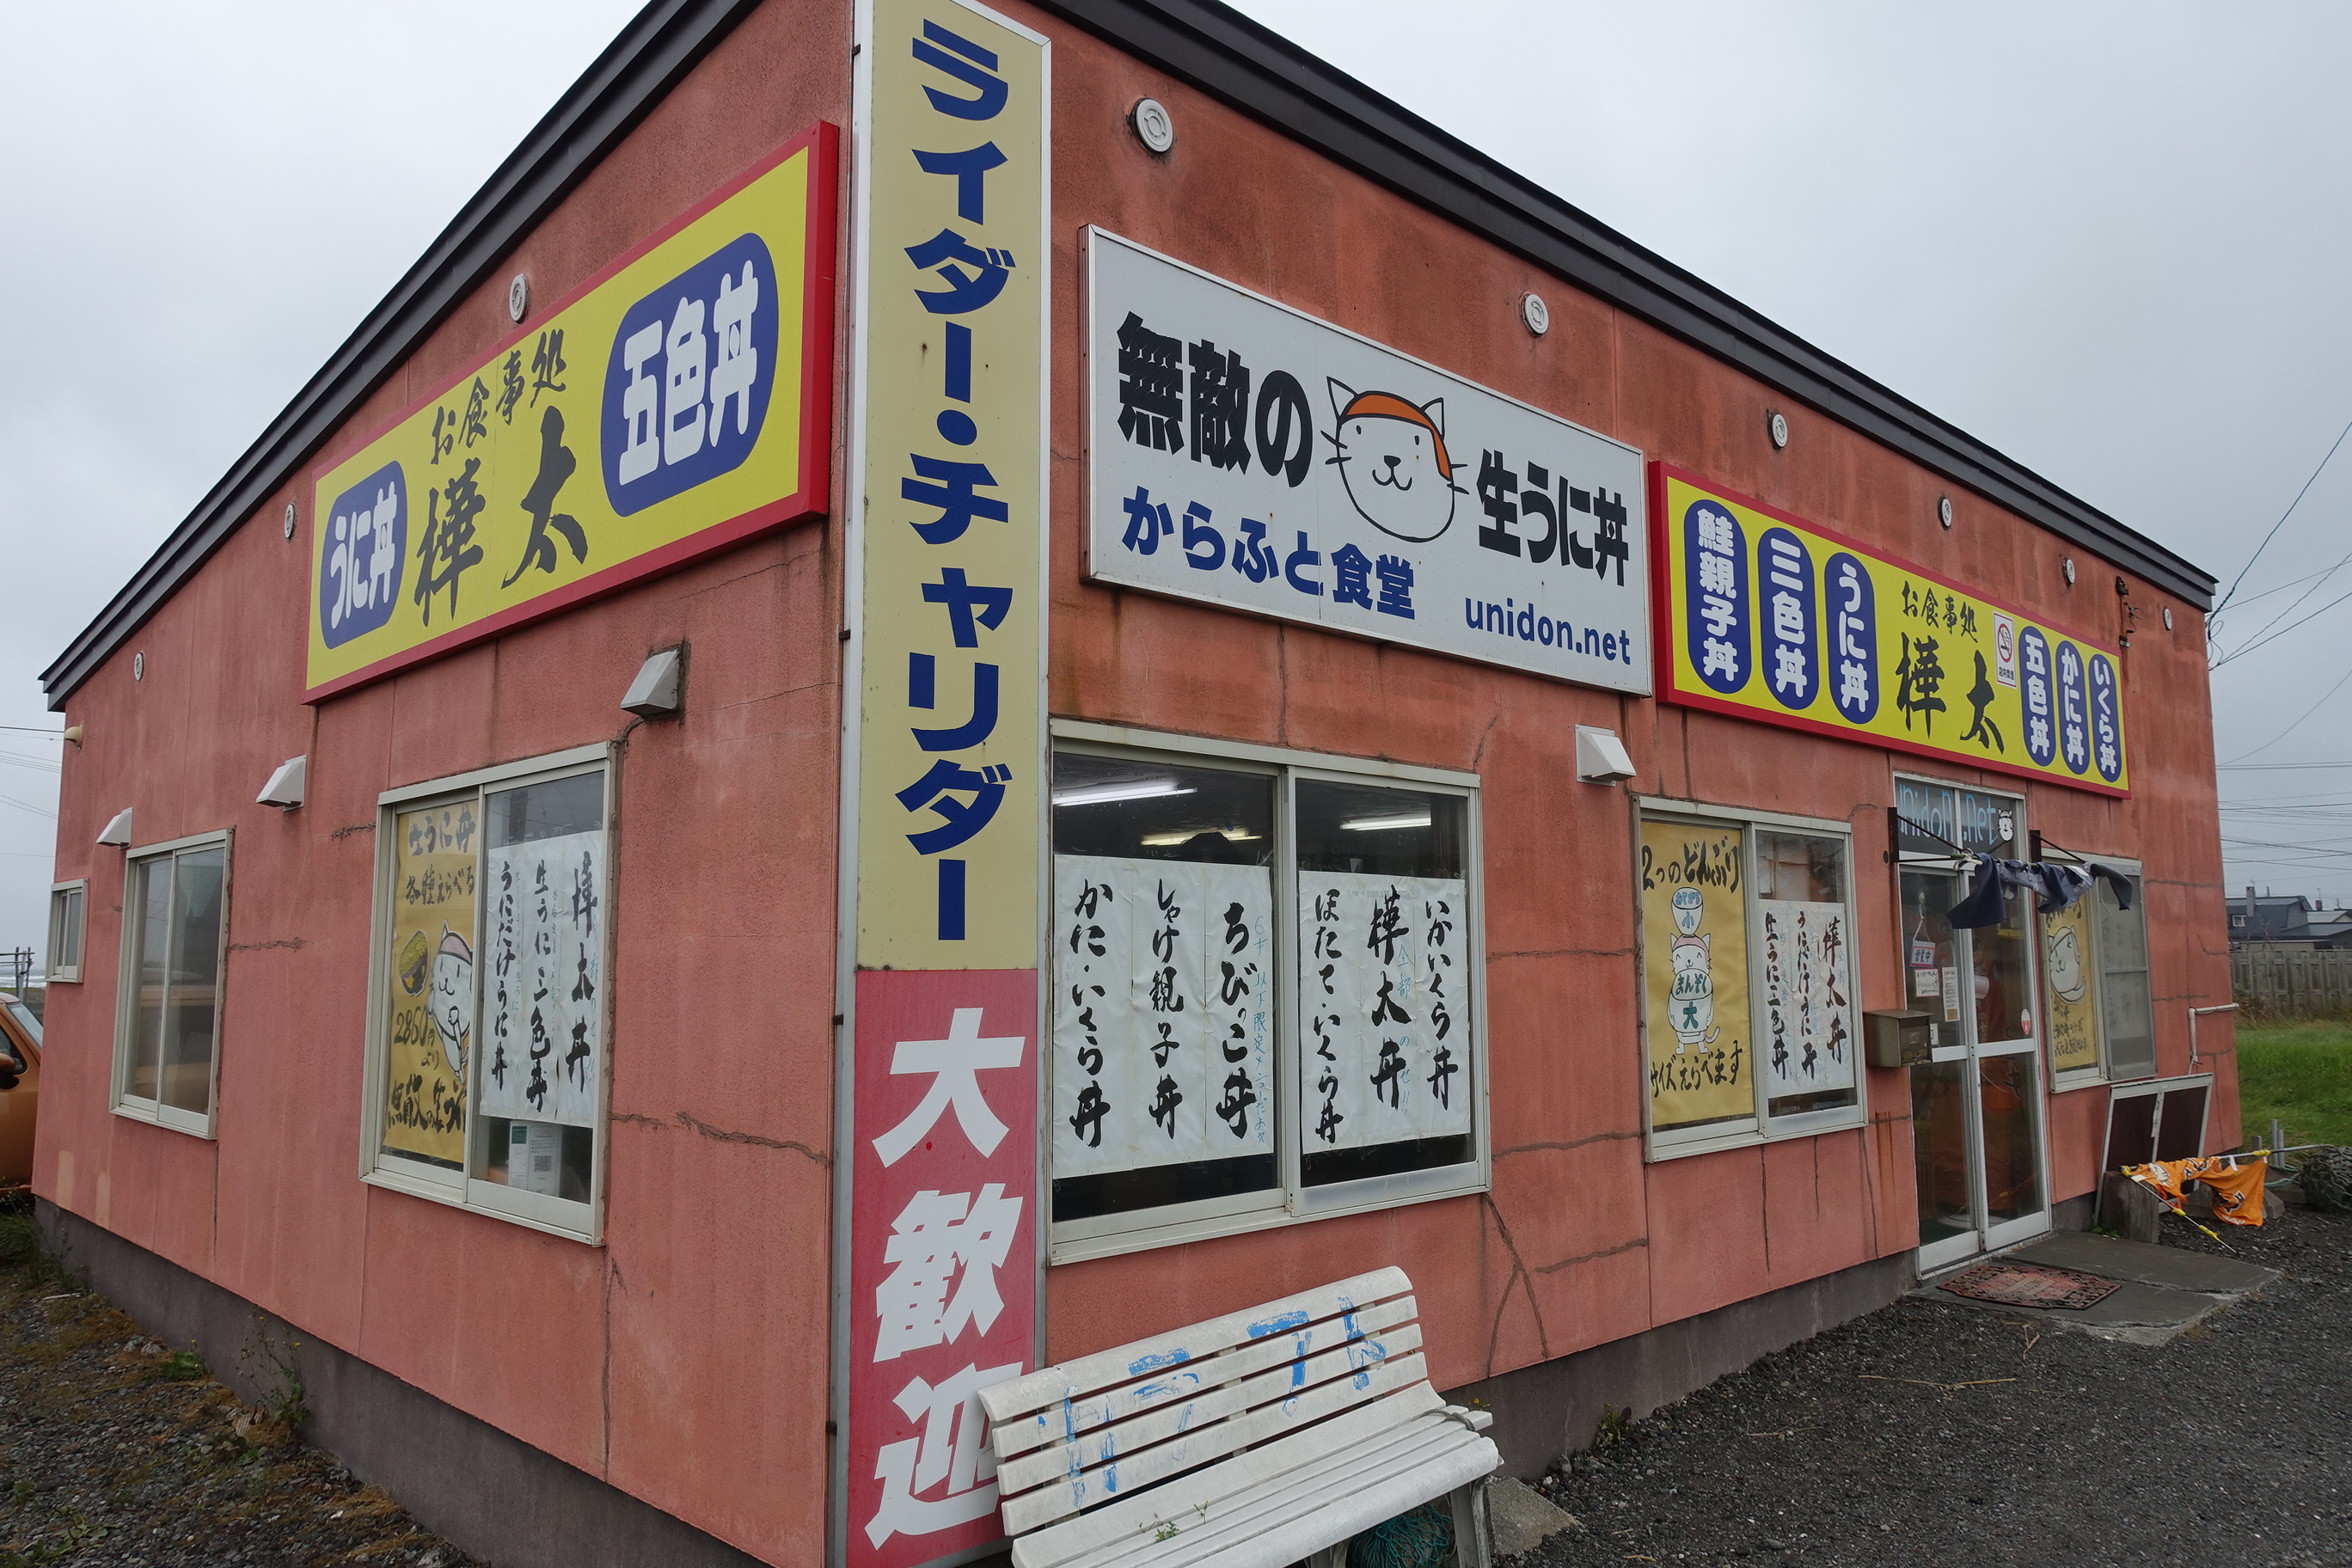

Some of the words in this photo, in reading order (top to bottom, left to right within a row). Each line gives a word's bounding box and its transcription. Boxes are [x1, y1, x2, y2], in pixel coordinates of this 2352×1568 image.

[431, 328, 567, 465] お食事処
[619, 260, 759, 486] 五色丼
[1117, 311, 1313, 487] 無敵の
[413, 405, 589, 628] 樺太
[895, 18, 1016, 940] ライダー・チャリダー
[1122, 485, 1415, 619] からふと食堂
[1476, 449, 1628, 586] 生うに丼
[330, 481, 398, 630] うに丼
[1697, 508, 1739, 682] 鮭親子丼
[1769, 537, 1808, 698] 三色丼
[1902, 580, 1979, 644] お食事処
[1465, 597, 1630, 665] unidon.net
[1838, 562, 1869, 714] うに丼
[1896, 632, 2006, 755] 樺太
[2025, 633, 2050, 757] 五色丼
[2061, 647, 2084, 768] かに丼
[2092, 659, 2116, 775] いくら丼
[409, 804, 475, 855] 生うに丼
[1675, 973, 1707, 995] まんぞく
[1681, 911, 1695, 928] 小
[1069, 879, 1112, 1148] かに・いくら丼
[1148, 879, 1185, 1139] しゃけ親子丼
[1216, 902, 1258, 1139] ちびっこ丼
[1313, 889, 1344, 1143] ほたて・いくら丼
[1368, 885, 1412, 1111] 樺太丼
[1426, 900, 1458, 1110] いかいくら丼
[1682, 1001, 1699, 1030] 大
[864, 1007, 1026, 1550] 大歓迎
